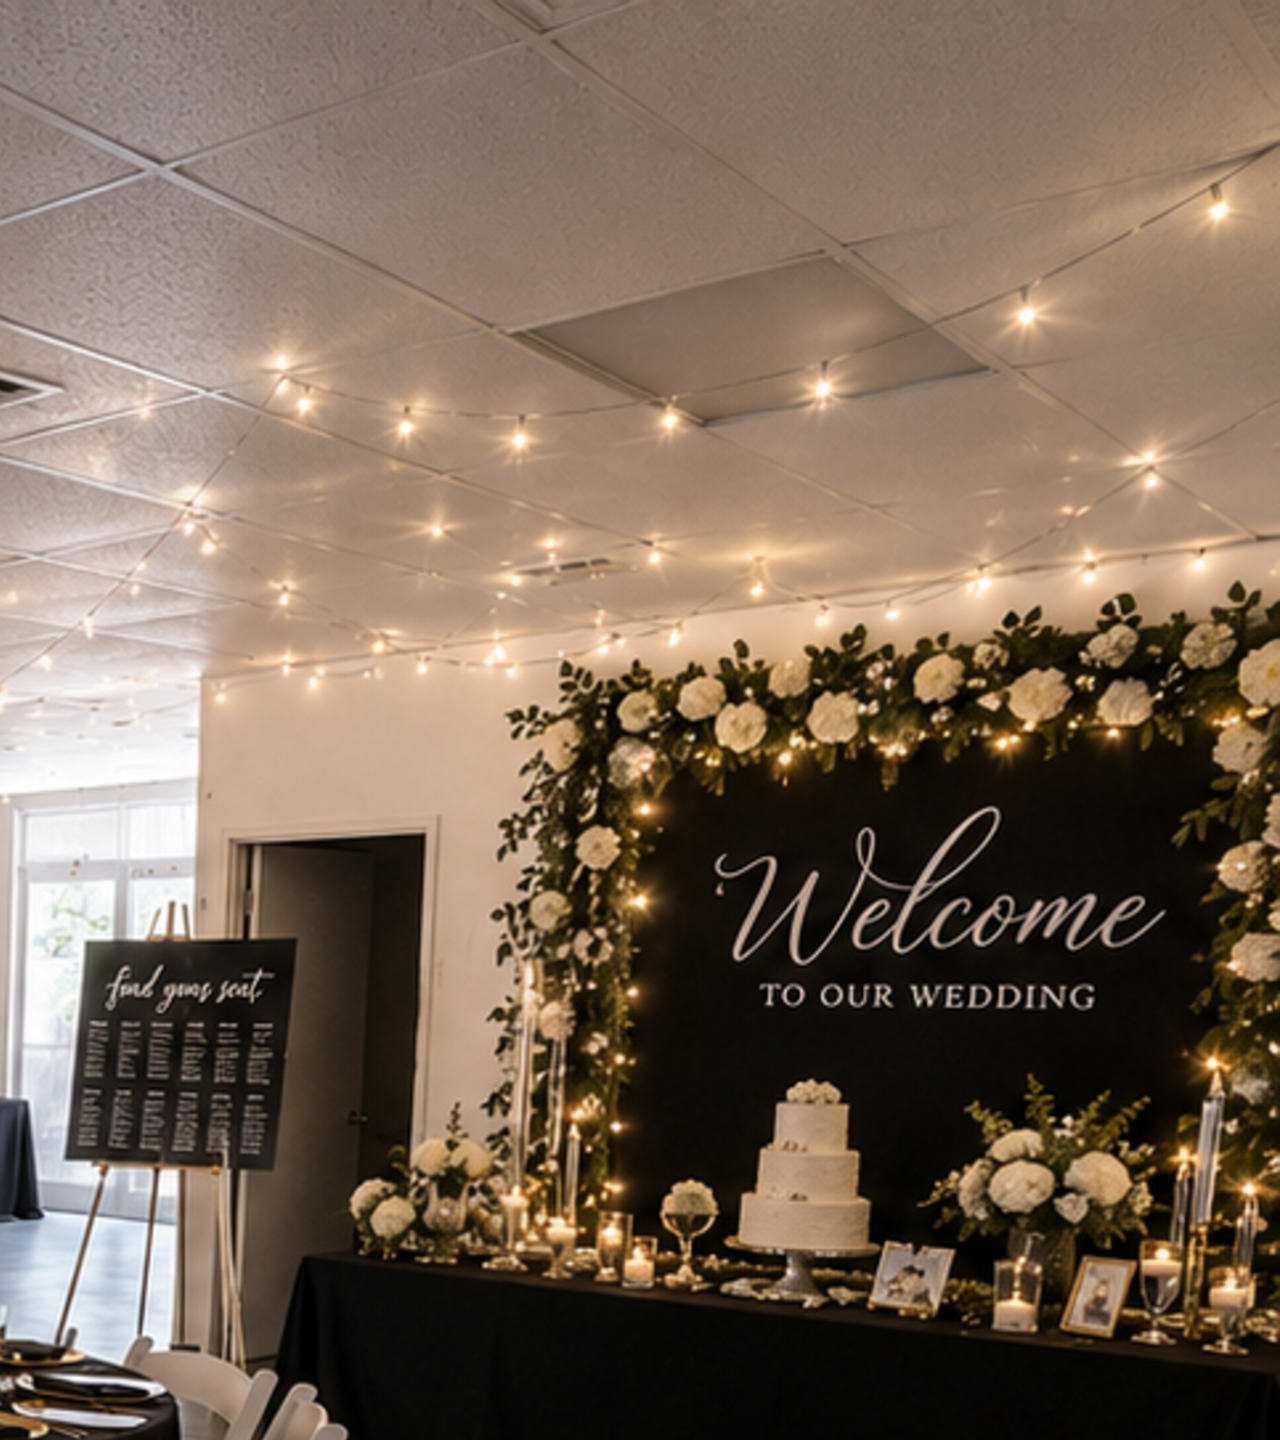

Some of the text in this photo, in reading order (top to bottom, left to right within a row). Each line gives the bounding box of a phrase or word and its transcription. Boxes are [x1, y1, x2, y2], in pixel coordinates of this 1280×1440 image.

[714, 805, 1166, 966] Welcome
[759, 983, 1095, 1011] TO OUR WEDDING
